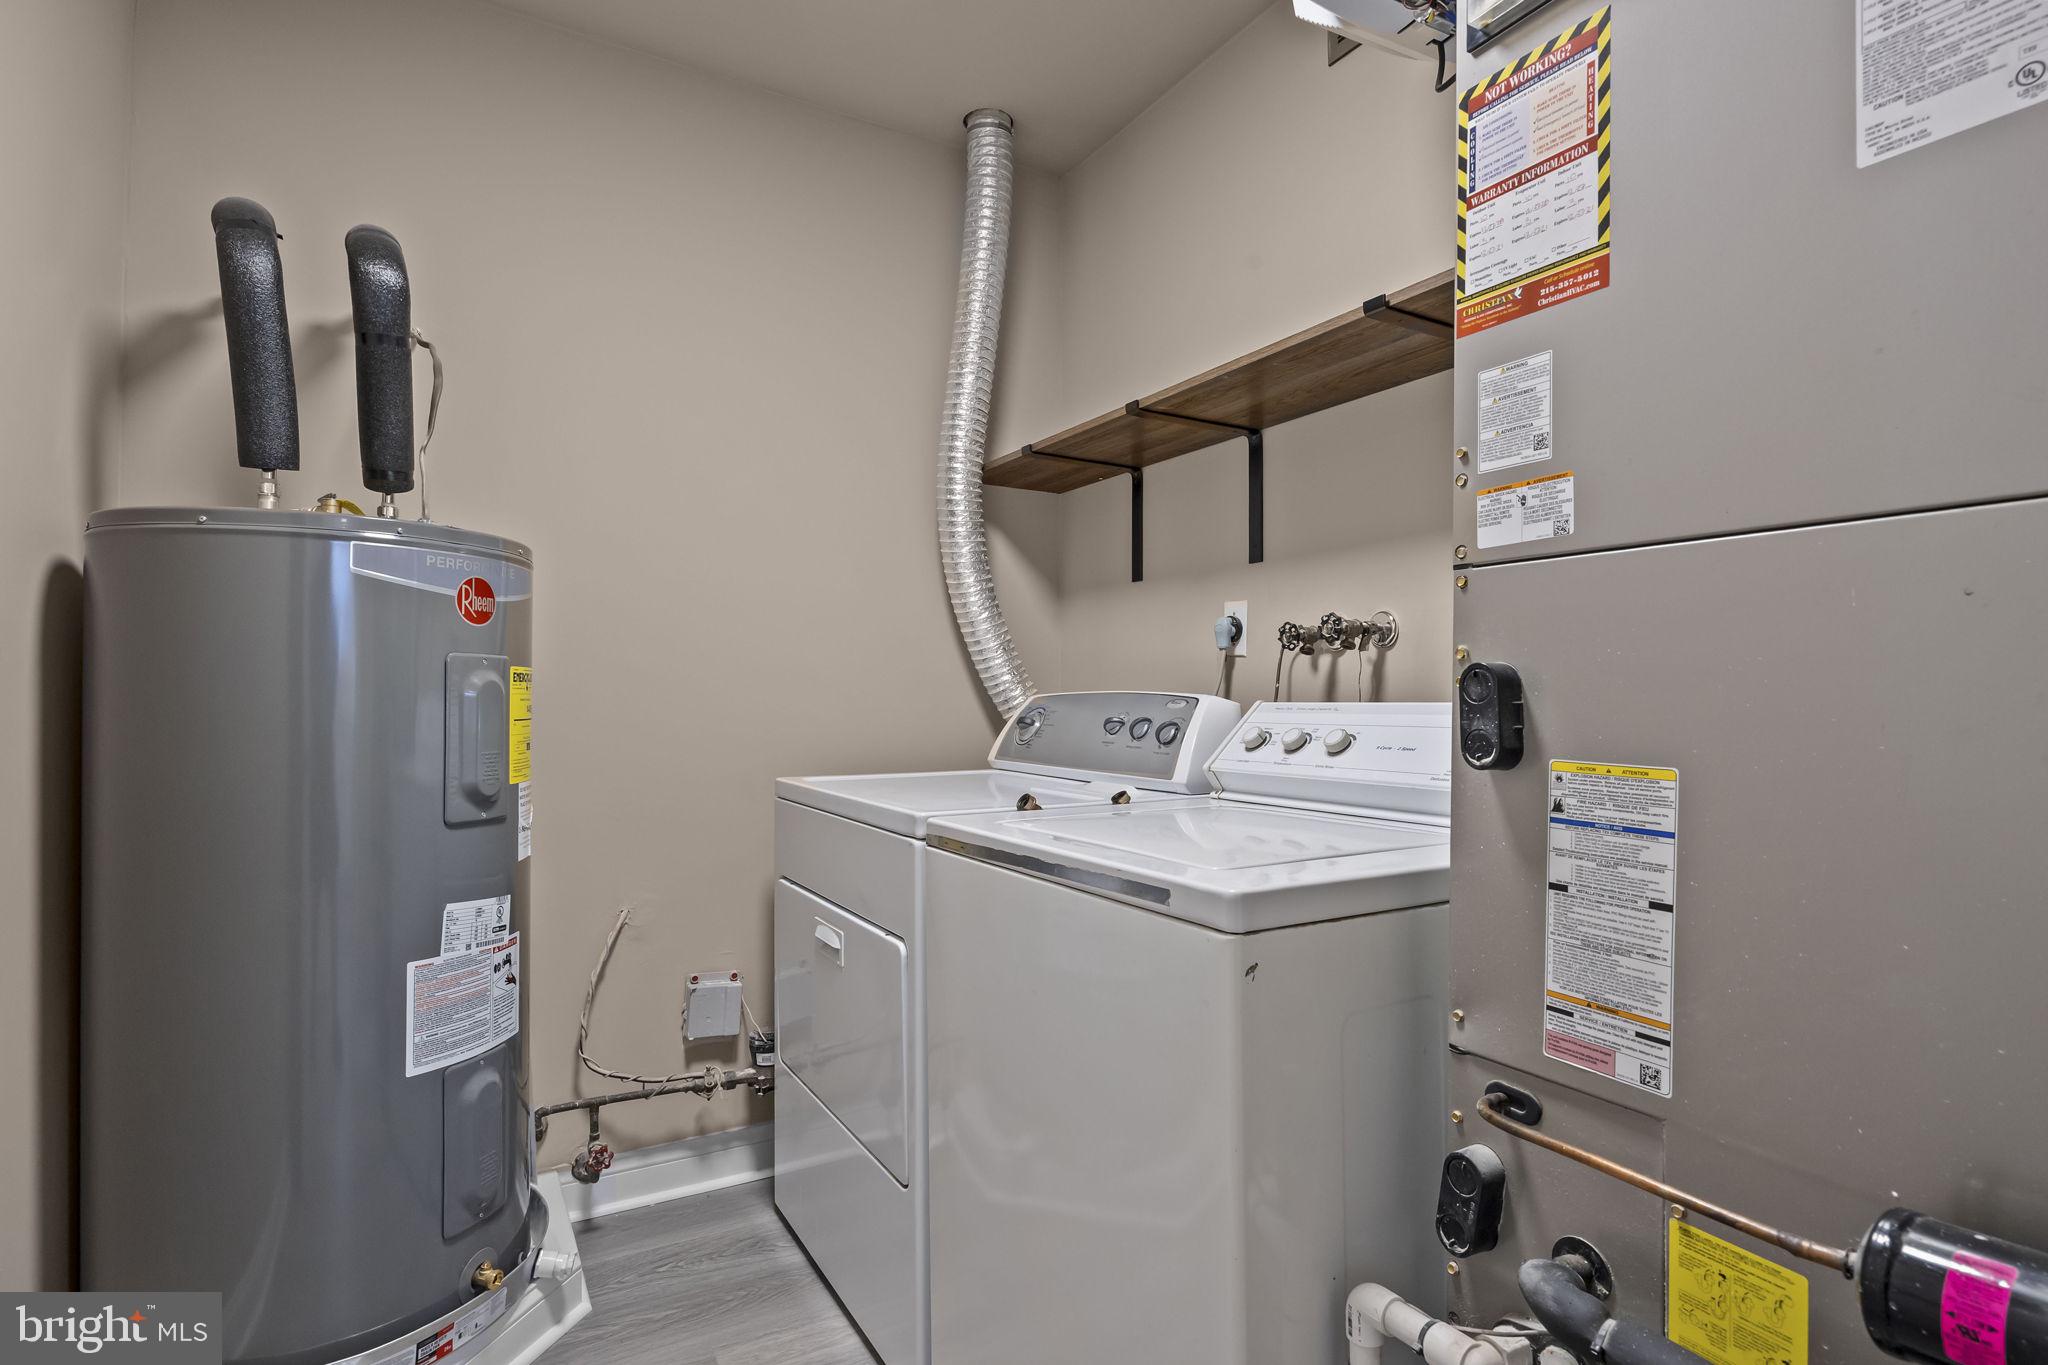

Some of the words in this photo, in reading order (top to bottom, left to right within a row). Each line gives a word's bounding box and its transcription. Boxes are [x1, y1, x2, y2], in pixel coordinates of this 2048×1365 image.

[1485, 79, 1507, 103] NOT
[1509, 43, 1570, 89] WORKING?
[1873, 94, 1903, 110] CAUTION
[1471, 175, 1518, 207] WARRANTY
[1522, 142, 1588, 183] INFORMATION
[1538, 279, 1599, 306] ChristianHVAC.com
[1540, 268, 1598, 295] 215-357-5012
[1463, 292, 1512, 317] CHRISTIAN
[1498, 386, 1538, 402] AVERTISSEMENT
[1500, 422, 1534, 435] ADVERTENCIA
[461, 577, 494, 618] Rheem
